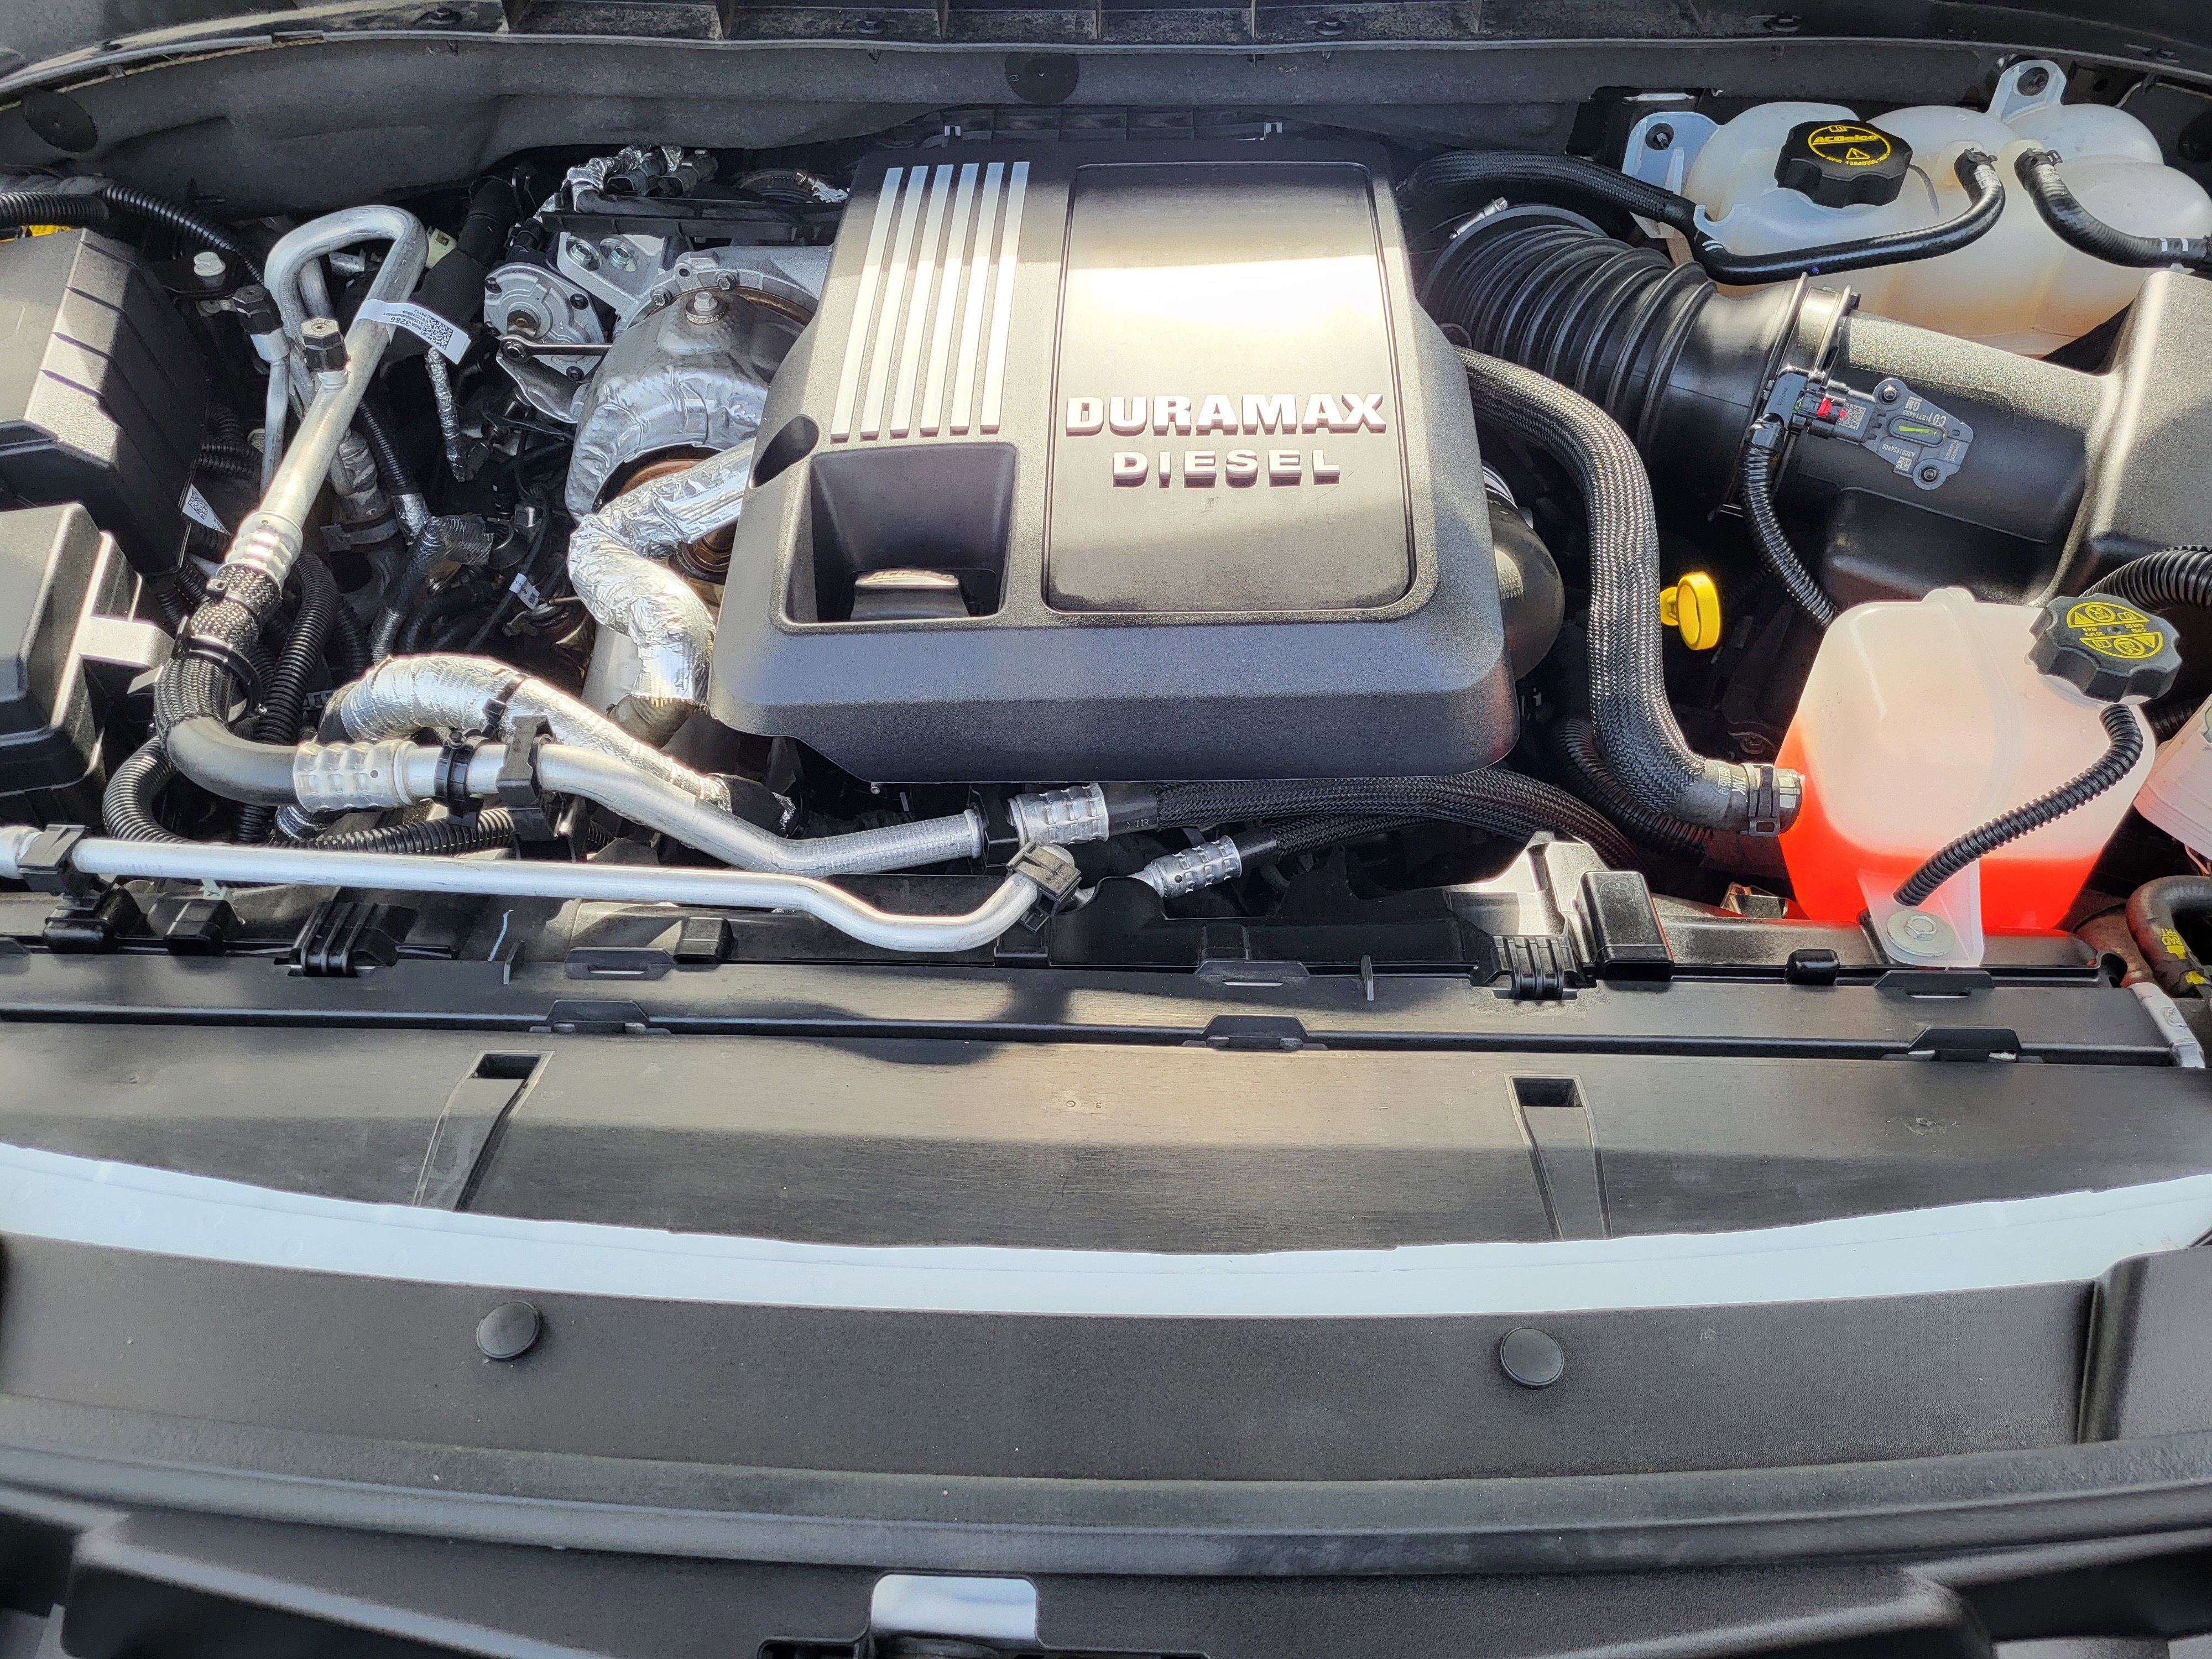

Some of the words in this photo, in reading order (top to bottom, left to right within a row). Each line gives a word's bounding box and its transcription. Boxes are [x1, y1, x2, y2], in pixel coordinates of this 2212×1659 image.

[390, 317, 411, 327] 3286
[1905, 398, 1922, 411] GM
[1066, 393, 1386, 437] DURAMAX
[1113, 450, 1340, 488] DIESEL
[1136, 818, 1149, 827] IIR
[2161, 928, 2178, 937] FRT
[2162, 936, 2183, 946] RAD
